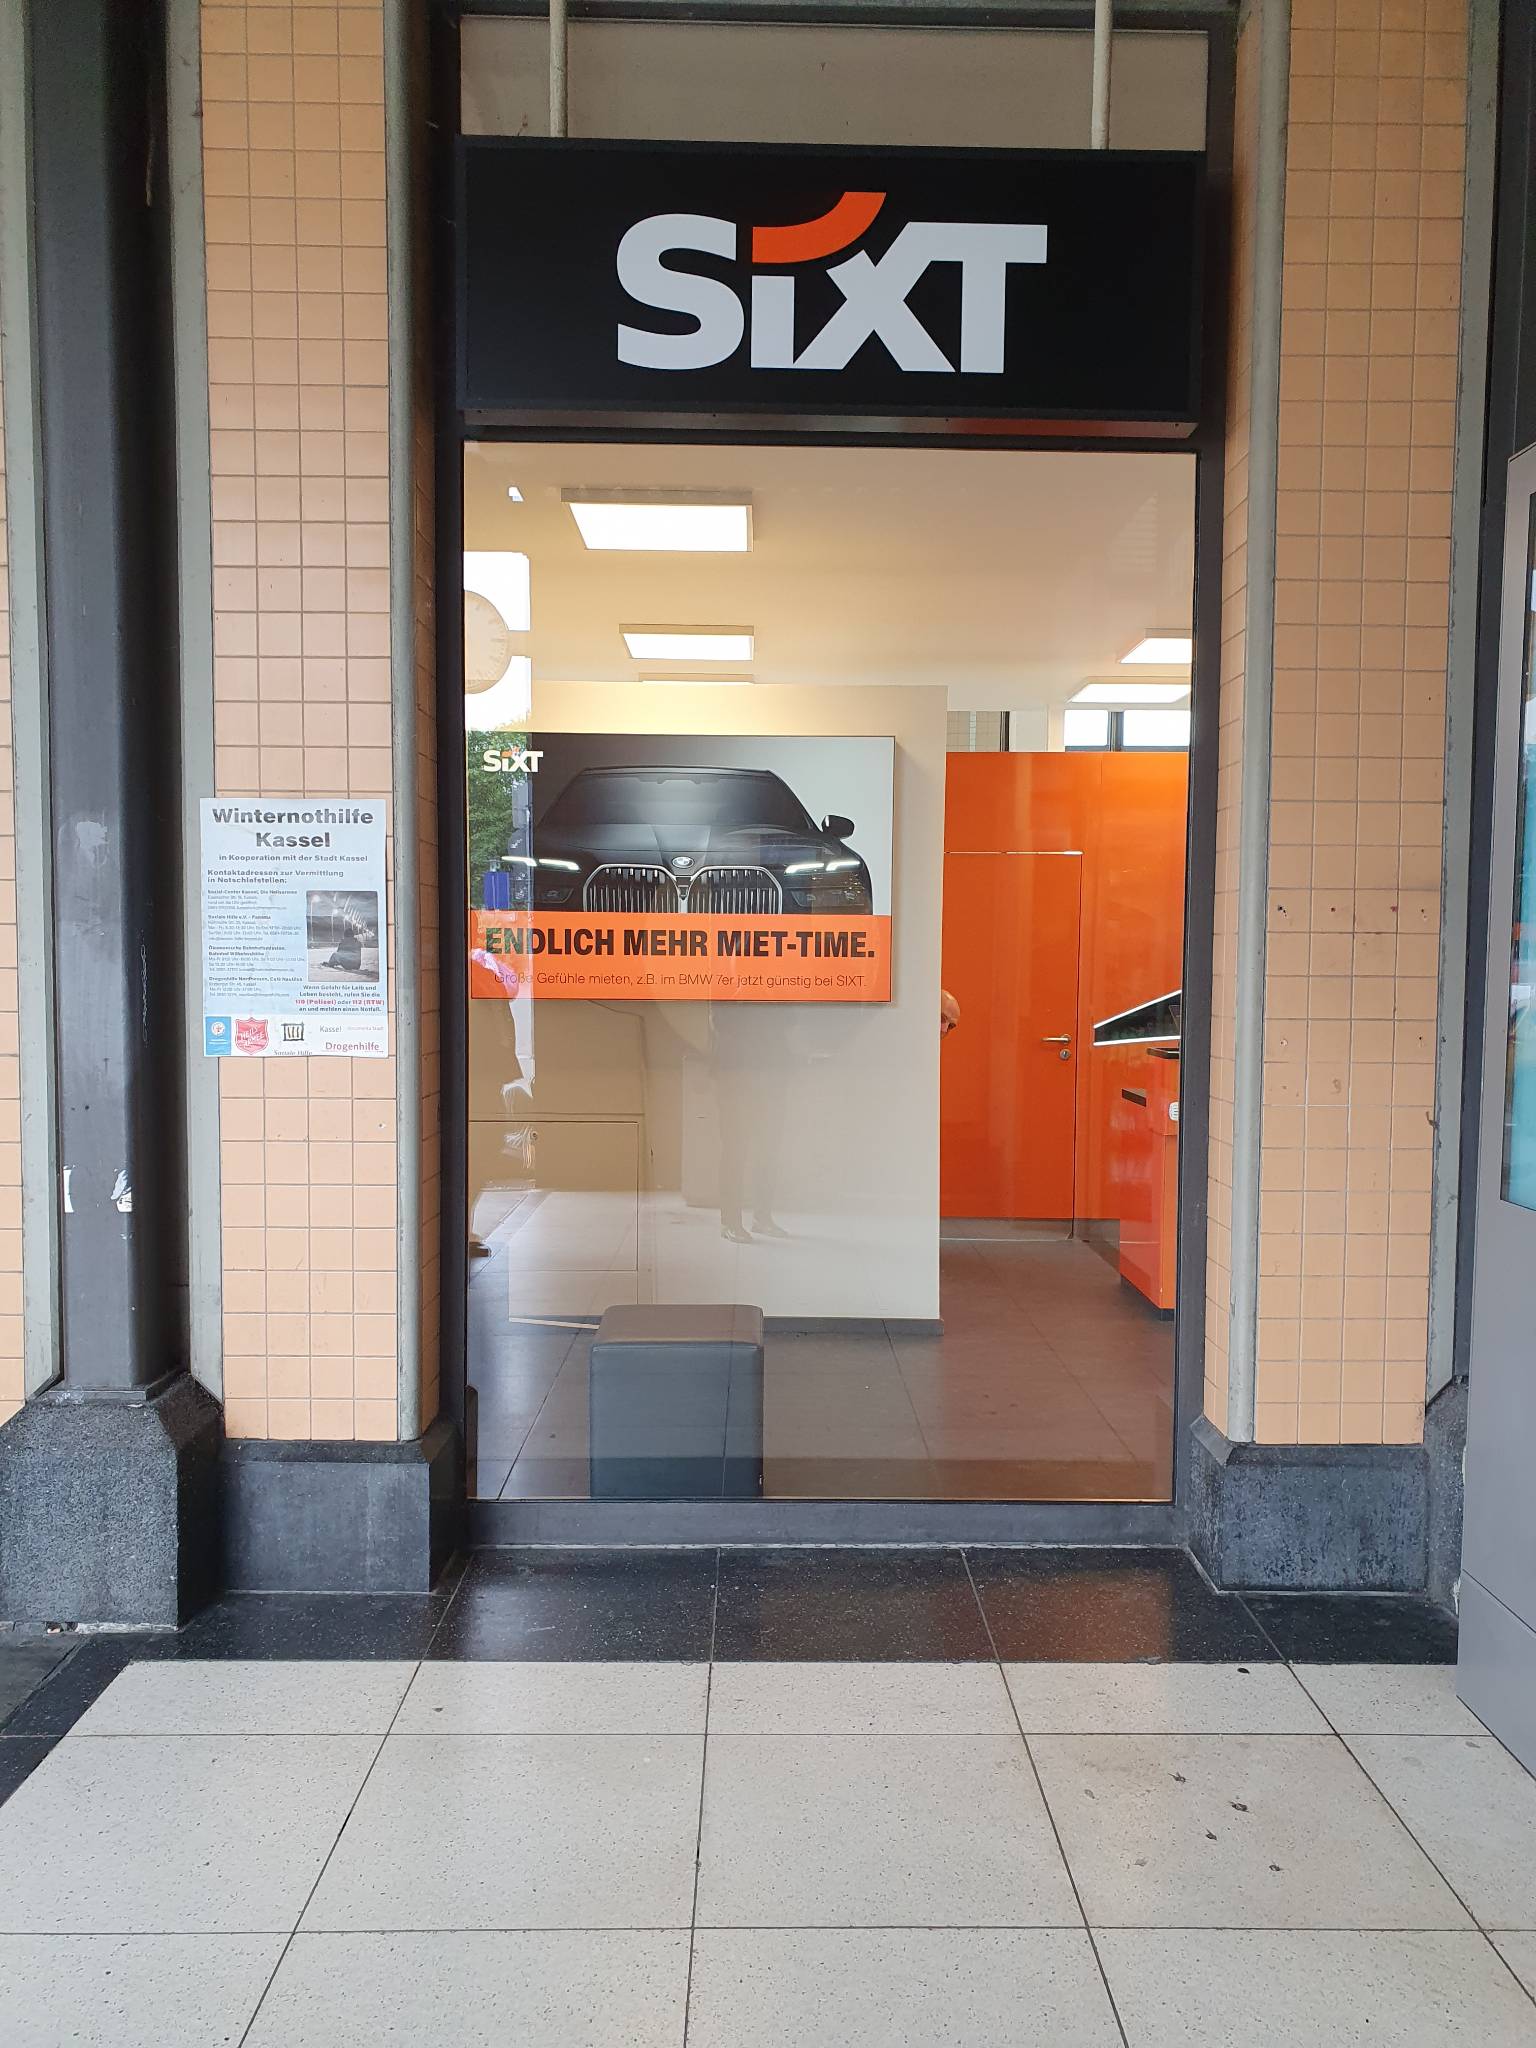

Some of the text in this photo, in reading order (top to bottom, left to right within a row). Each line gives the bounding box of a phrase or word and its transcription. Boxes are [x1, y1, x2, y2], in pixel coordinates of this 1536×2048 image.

[212, 808, 373, 824] Winternothilfe
[256, 832, 330, 848] Kassel
[229, 854, 281, 862] Kooperation
[485, 927, 875, 958] ENDLICH MEHR MIET-TIME.
[537, 971, 585, 985] Gefühle
[588, 973, 633, 986] mieten,
[660, 974, 675, 985] im
[679, 974, 713, 985] BMW
[716, 974, 734, 986] 7er
[736, 975, 763, 988] jetzt
[766, 975, 811, 988] günstig
[814, 975, 833, 987] bei
[836, 975, 867, 987] SIXT.
[325, 1042, 380, 1052] Drogenhilfe
